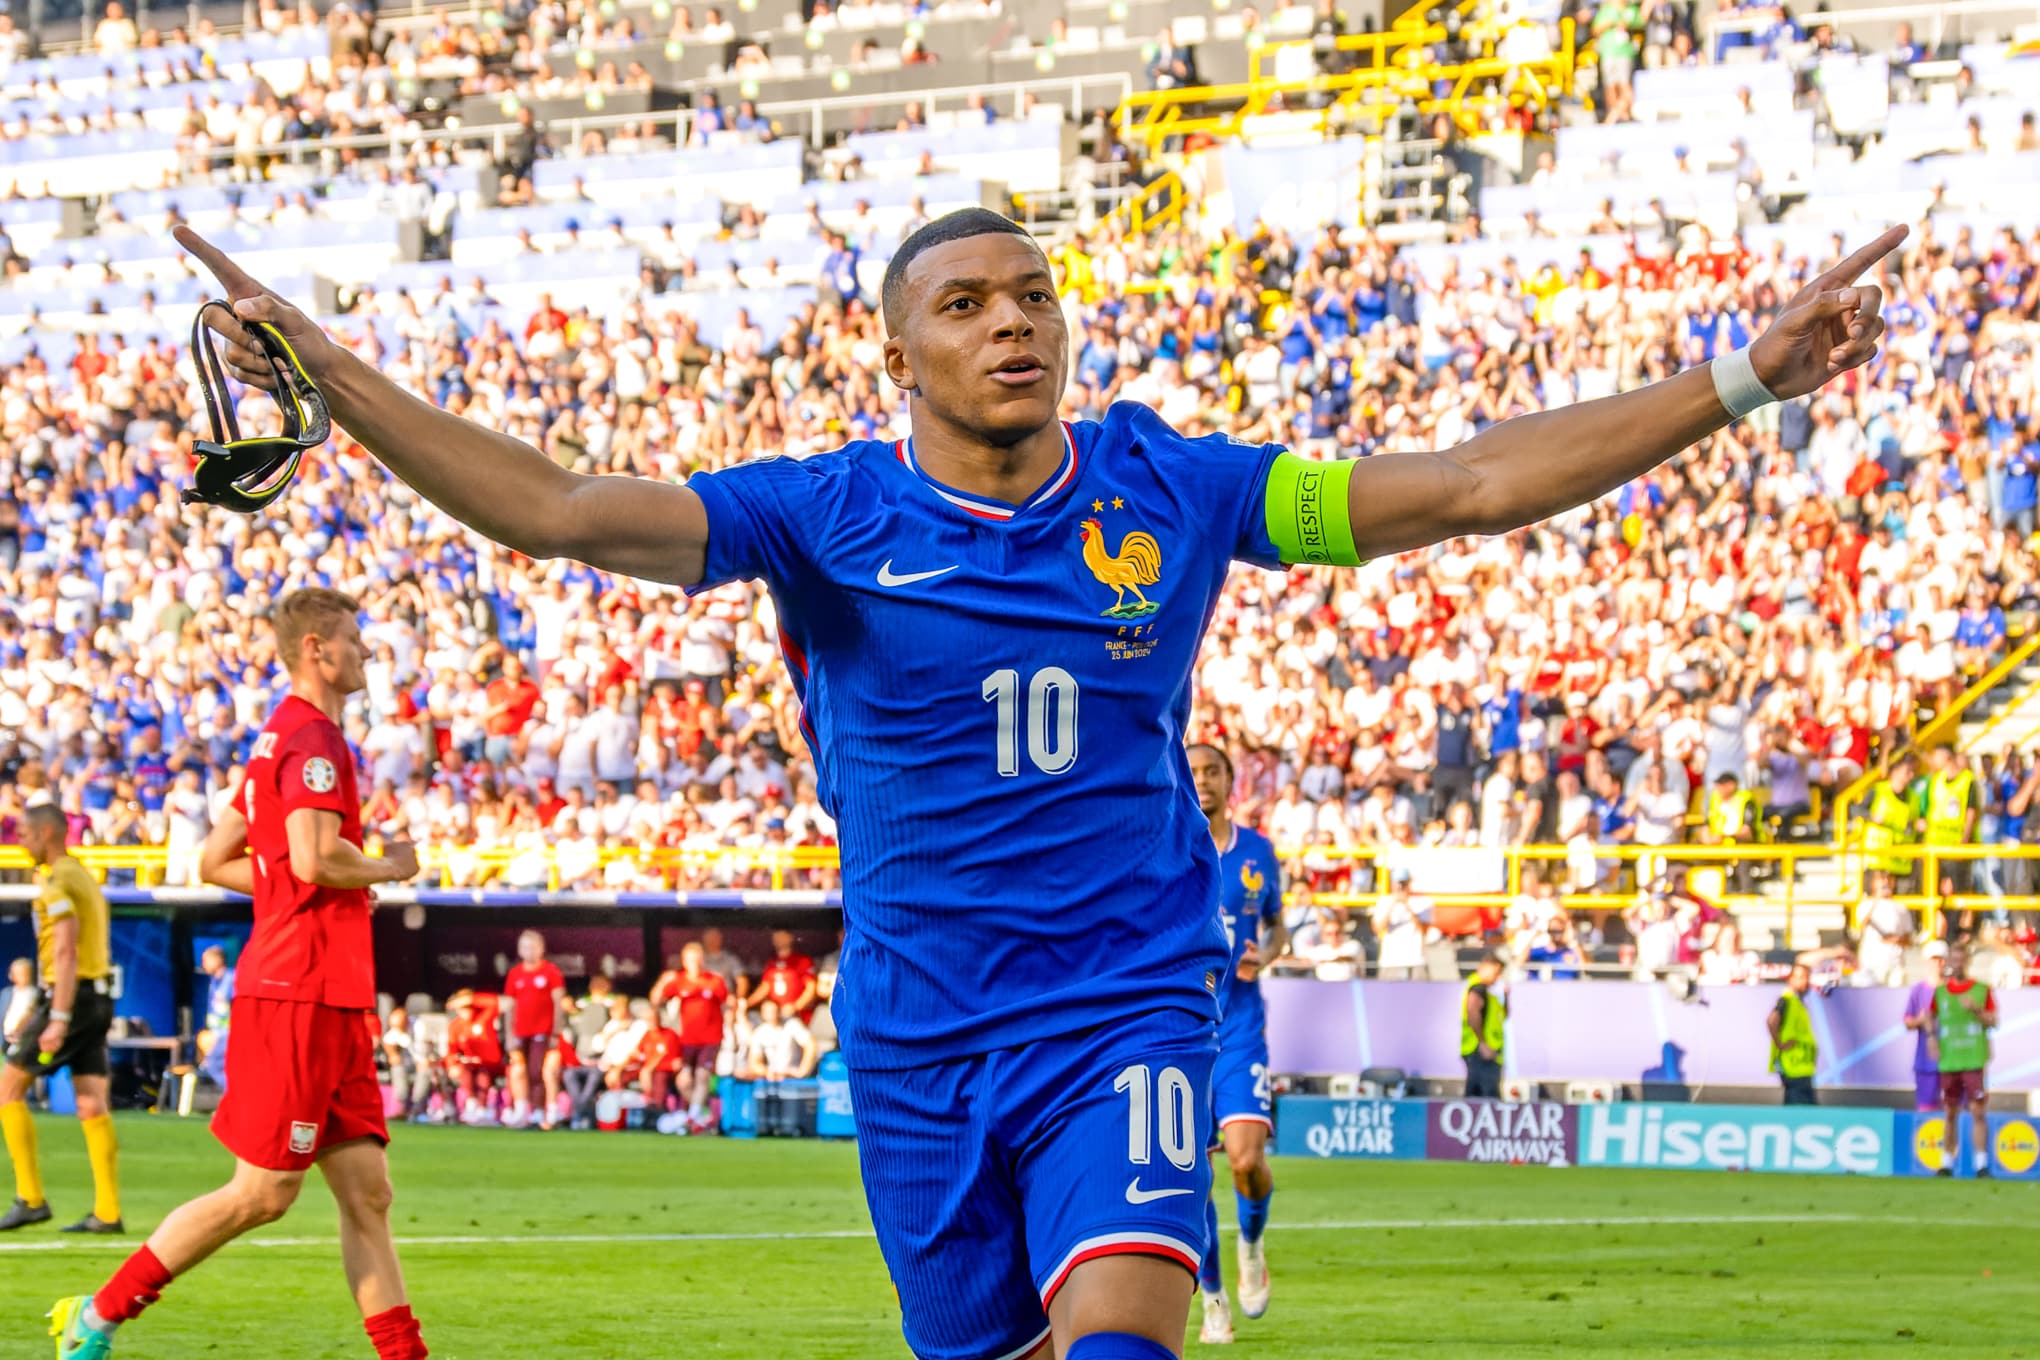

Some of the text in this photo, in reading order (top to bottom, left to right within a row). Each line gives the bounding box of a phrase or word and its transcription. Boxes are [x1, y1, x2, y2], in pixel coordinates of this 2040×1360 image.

[1301, 471, 1320, 546] RESPECT
[1111, 651, 1121, 660] 25
[982, 666, 1079, 777] 10
[1113, 1064, 1195, 1171] 10
[1333, 1100, 1395, 1126] visit
[1439, 1102, 1565, 1145] QATAR
[1306, 1124, 1394, 1157] QATAR
[1466, 1139, 1565, 1163] AIRWAYS
[1588, 1105, 1881, 1172] Hisense
